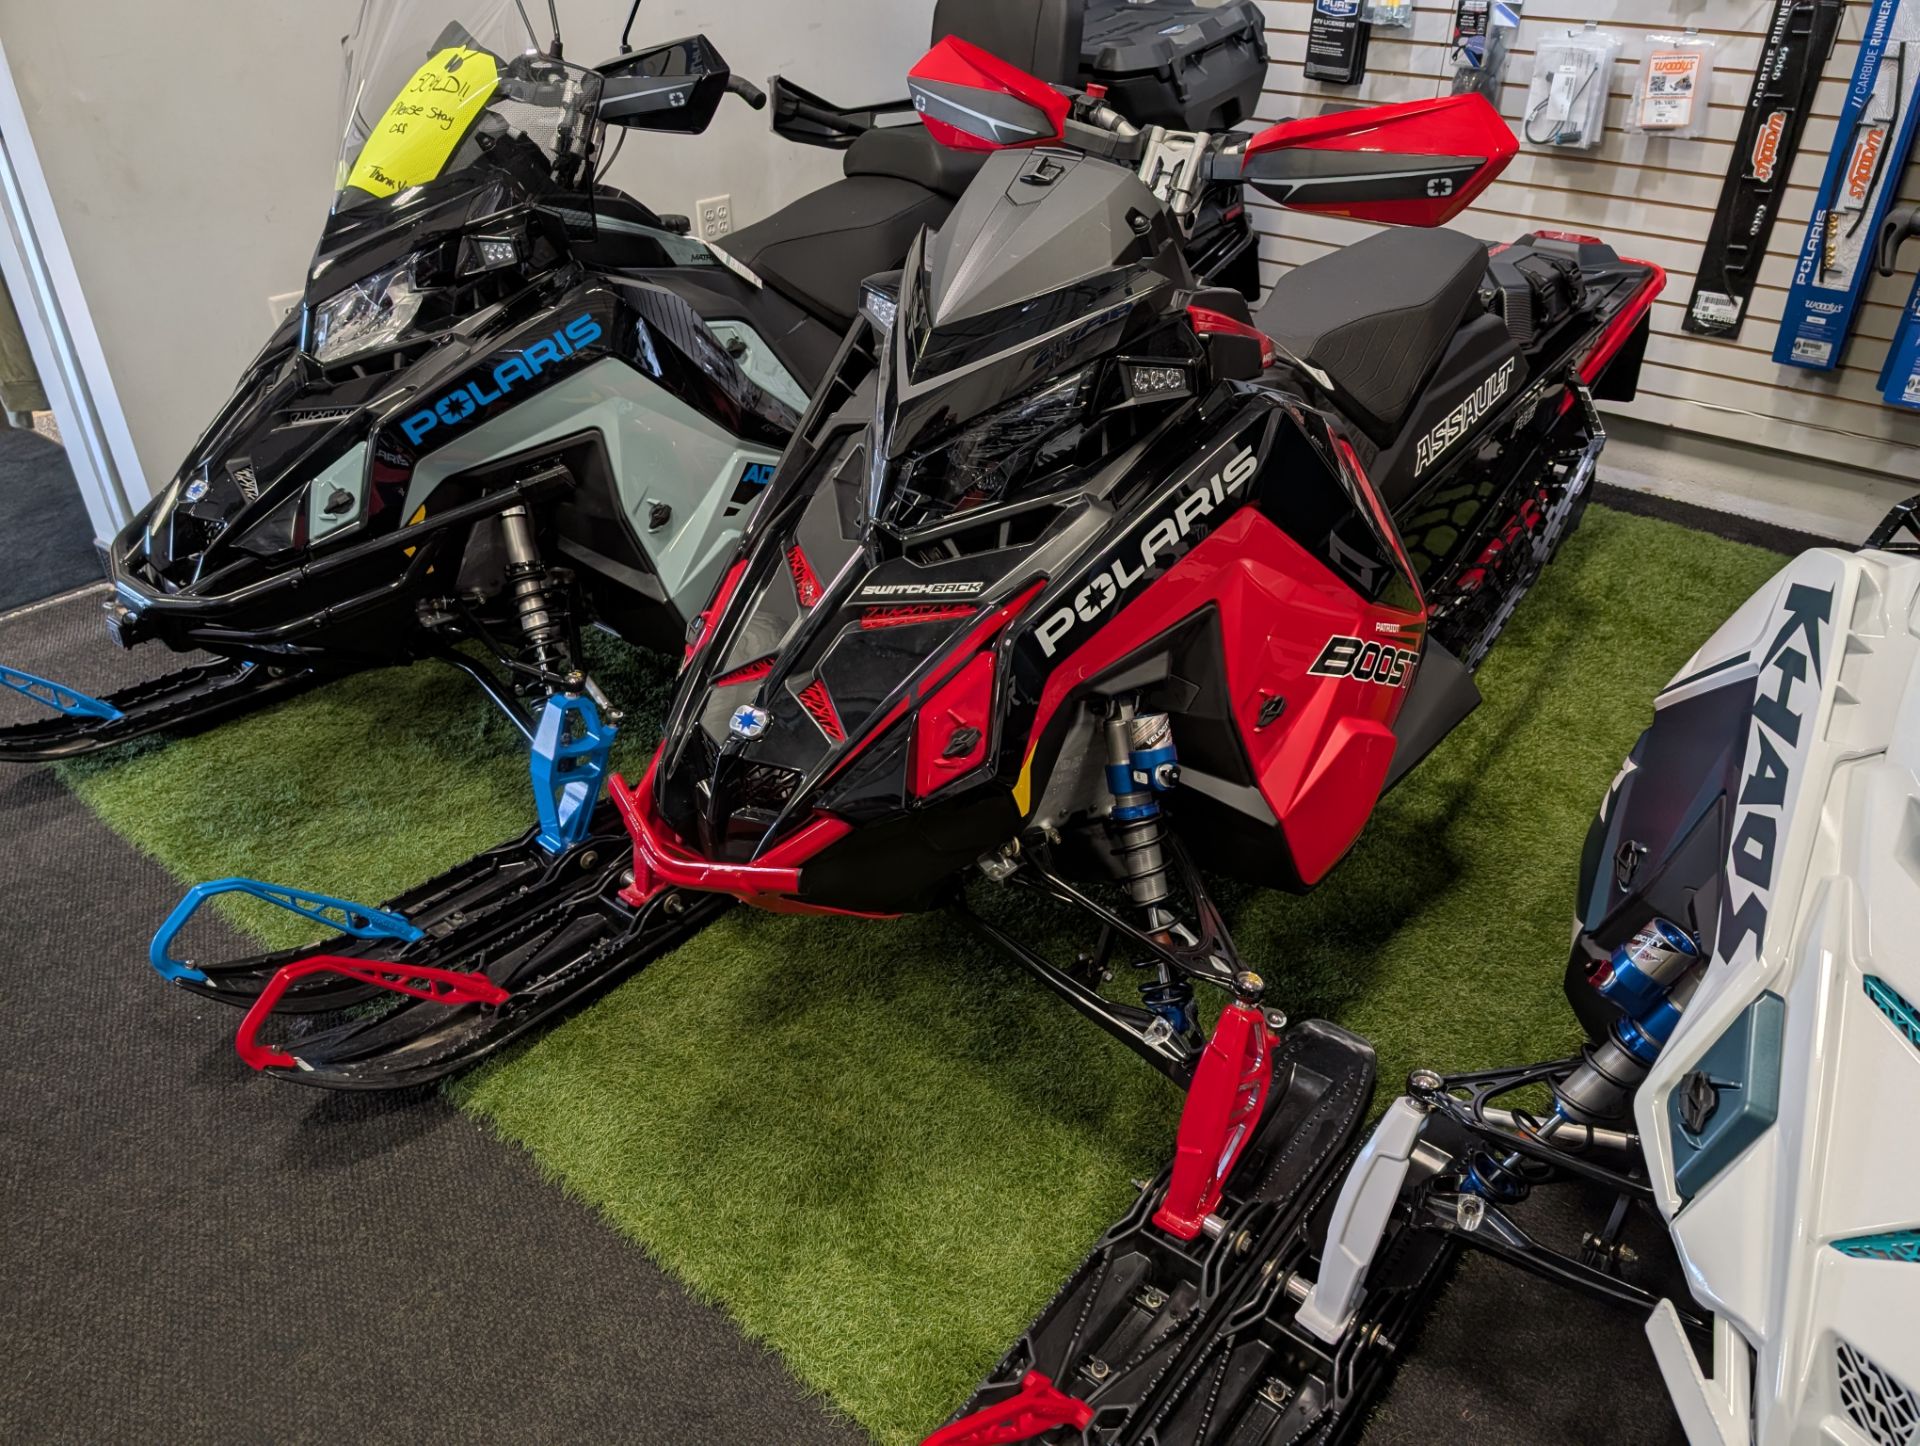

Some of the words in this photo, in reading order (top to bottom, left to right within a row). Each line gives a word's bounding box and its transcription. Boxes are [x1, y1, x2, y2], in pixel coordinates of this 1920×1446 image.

[1771, 0, 1792, 44] RUNNE
[1855, 48, 1879, 94] CARBIDE
[426, 107, 455, 131] Stay
[691, 253, 714, 263] MATR
[1796, 209, 1827, 285] POLARIS
[400, 312, 603, 447] POLARIS
[1413, 355, 1516, 479] ASSAULT
[1034, 444, 1259, 659] POLARIS
[861, 581, 984, 596] SWITCHBACK
[1375, 622, 1401, 633] PATRIOT
[1306, 634, 1420, 689] BOOST
[1716, 580, 1836, 966] KHAOS
